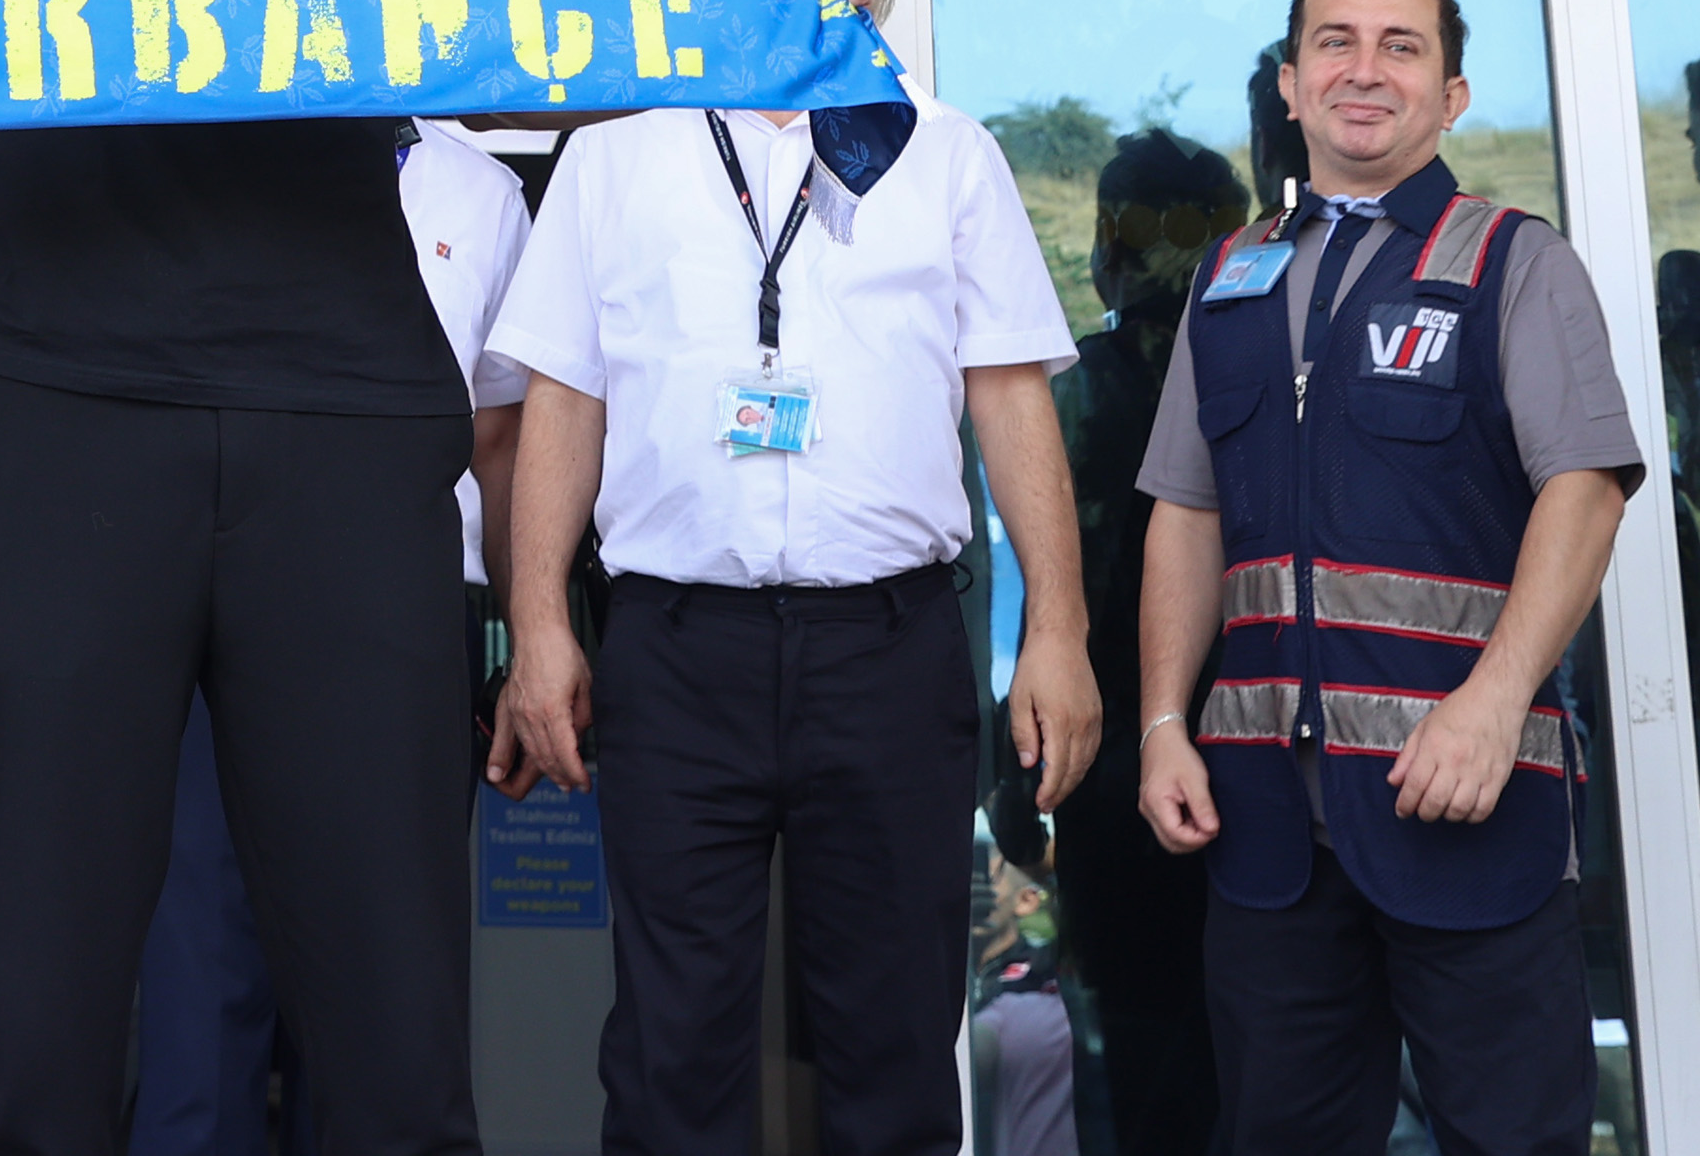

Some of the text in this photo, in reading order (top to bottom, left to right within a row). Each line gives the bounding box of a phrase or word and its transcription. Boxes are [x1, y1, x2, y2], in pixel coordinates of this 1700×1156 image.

[516, 856, 570, 871] Please
[491, 877, 595, 894] declare your
